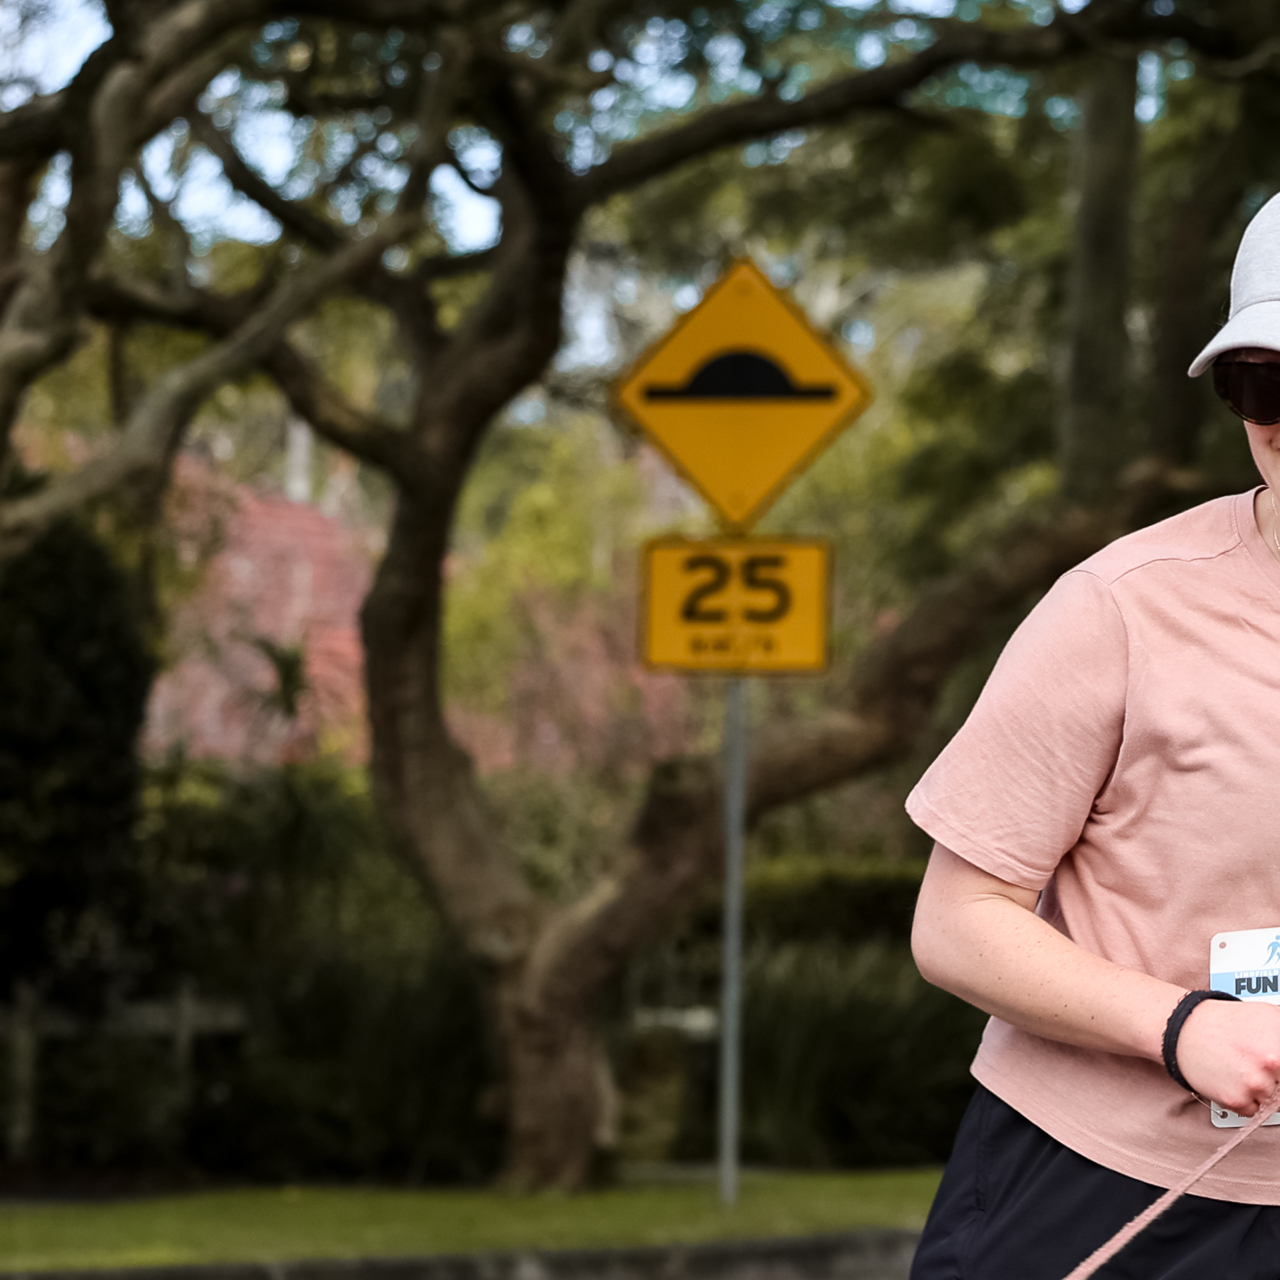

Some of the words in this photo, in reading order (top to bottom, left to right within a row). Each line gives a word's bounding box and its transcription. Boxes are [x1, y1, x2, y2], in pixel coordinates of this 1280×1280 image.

[681, 555, 792, 623] 25
[1234, 969, 1279, 979] LINDFIELD
[1235, 975, 1279, 995] FUN
